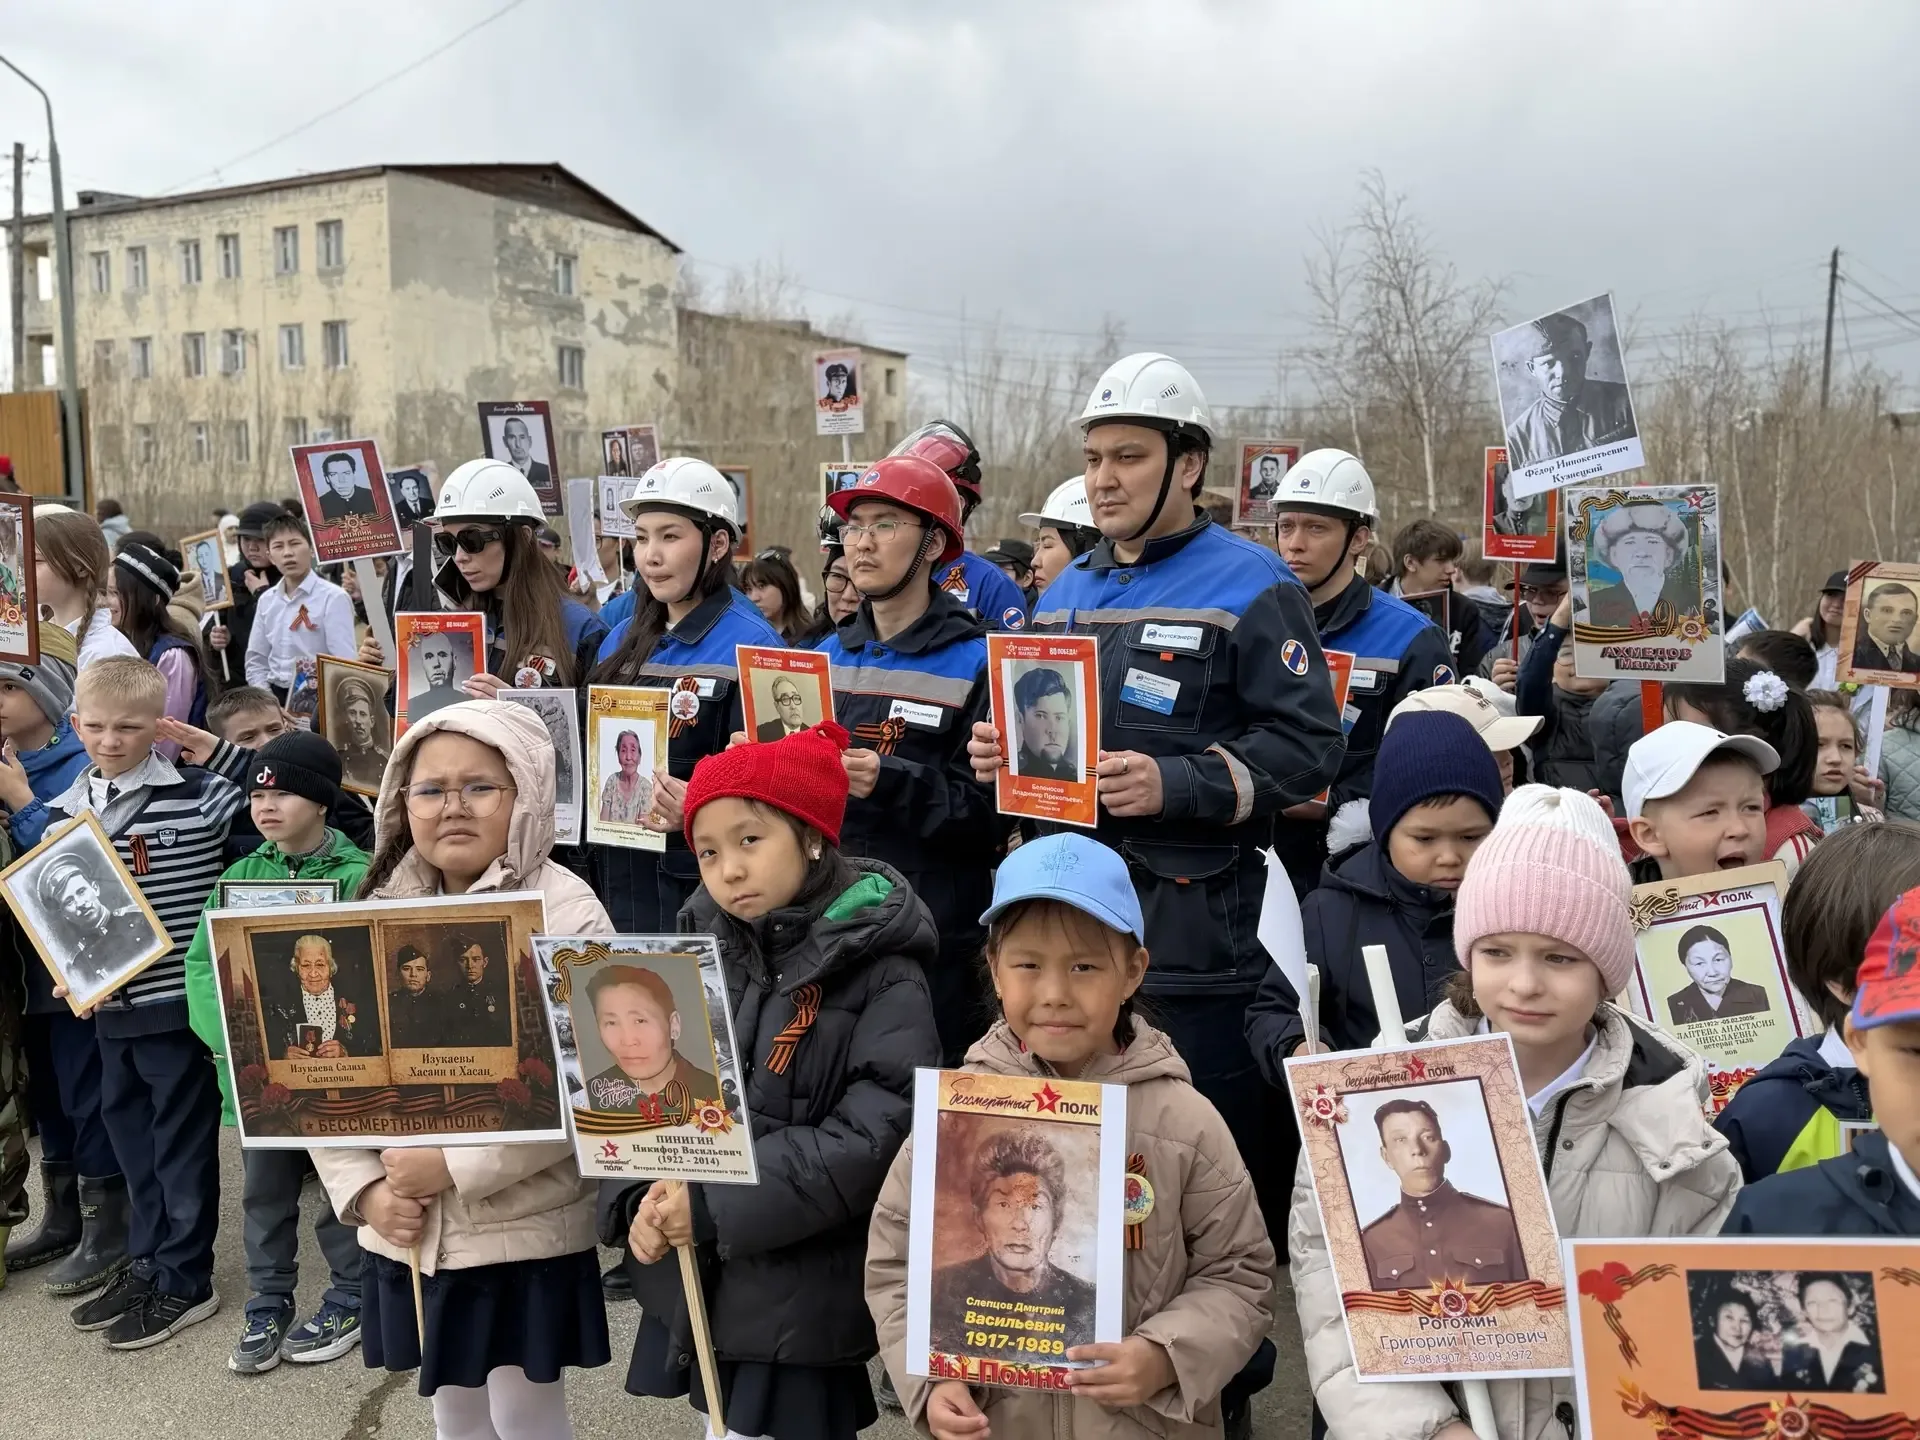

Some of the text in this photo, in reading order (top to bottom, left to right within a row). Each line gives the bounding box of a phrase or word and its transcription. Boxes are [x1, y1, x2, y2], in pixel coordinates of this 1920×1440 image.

[1525, 445, 1629, 479] Фёдор Иннокентьевич
[1552, 464, 1604, 483] Кузнецкий
[1600, 646, 1693, 663] АХМЕДОВ
[1721, 890, 1754, 904] ПОЛК
[1677, 1019, 1775, 1040] ЛАПТЕВА АНАСТАСИЯ
[1696, 1030, 1758, 1045] НИКОЛАЕВНА
[1703, 1041, 1733, 1053] ветеран
[422, 1053, 475, 1066] Изукаевы
[290, 1062, 367, 1074] Изукаева Салиха
[408, 1065, 490, 1077] Хасаин и Хасан
[1427, 1063, 1457, 1079] ПОЛК
[307, 1073, 355, 1084] Салиховна
[1059, 1101, 1099, 1117] ПОЛК
[318, 1112, 488, 1133] БЕССМЕРТНЫЙ ПОЛК
[655, 1135, 715, 1146] ПИНИГИН
[632, 1144, 742, 1157] Никифор Васильевич
[657, 1154, 684, 1165] (1922
[693, 1156, 720, 1167] 2014)
[966, 1296, 1065, 1316] Слепцов Дмитрий
[964, 1310, 1066, 1334] Васильевич
[1418, 1314, 1498, 1331] Рогожин
[965, 1331, 1065, 1355] 1917-1989
[1380, 1329, 1548, 1353] Григорий Петрович
